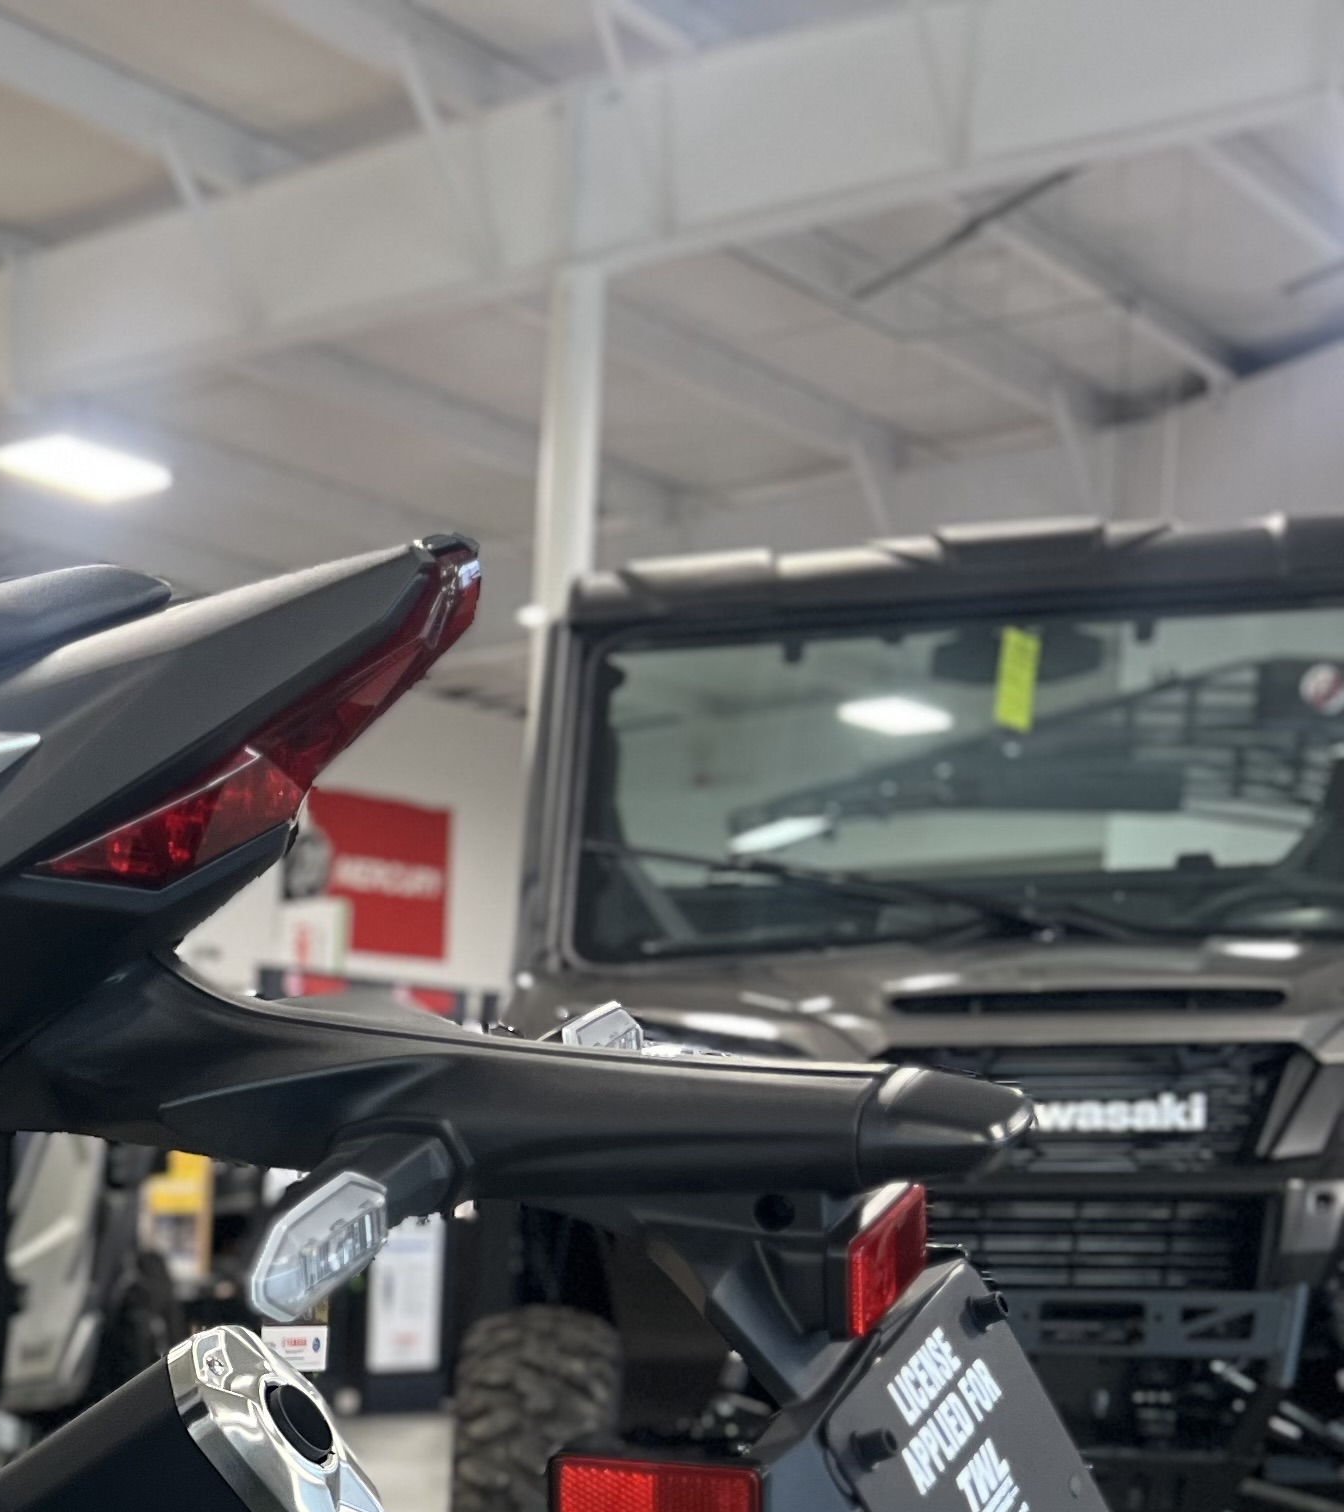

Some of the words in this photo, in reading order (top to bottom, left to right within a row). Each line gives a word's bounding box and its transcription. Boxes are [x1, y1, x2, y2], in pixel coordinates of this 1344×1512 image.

[1031, 1092, 1208, 1132] wasaki
[886, 1326, 963, 1427] LICENSE
[901, 1391, 975, 1497] APPLIED
[957, 1357, 1003, 1423] FOR
